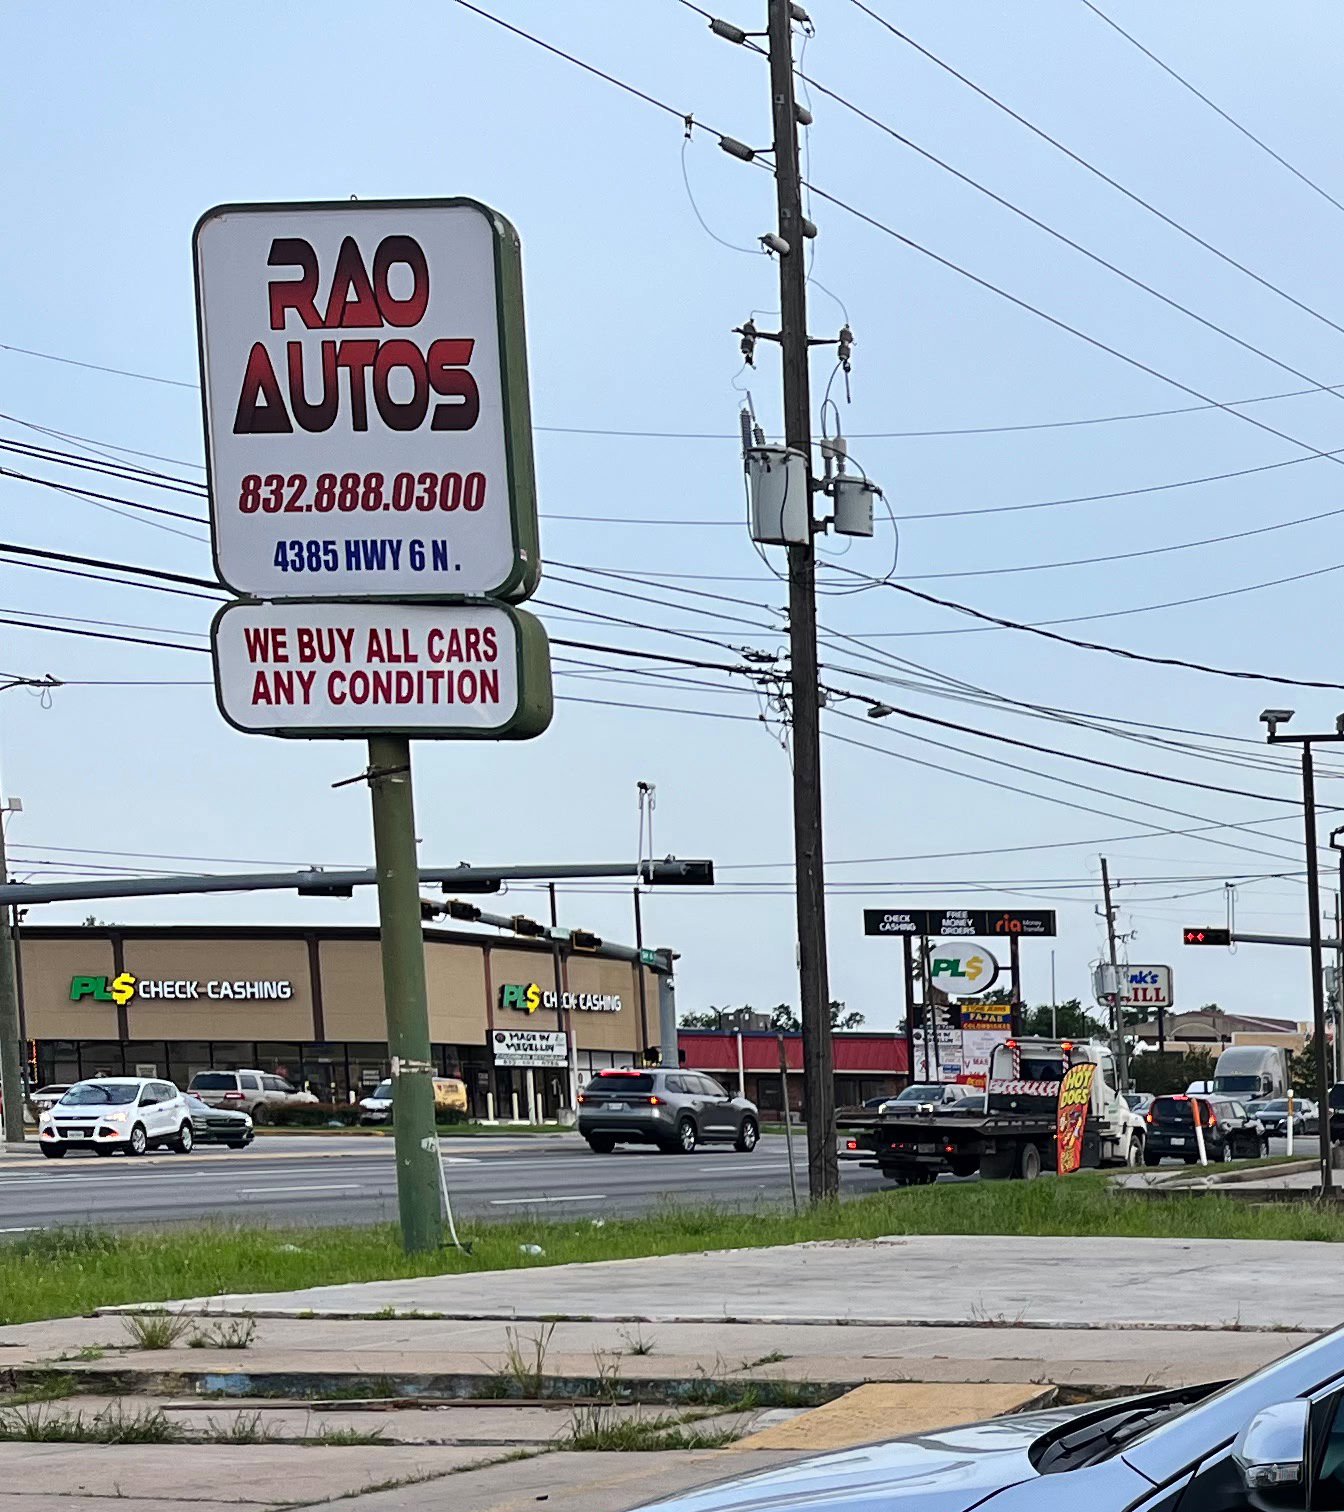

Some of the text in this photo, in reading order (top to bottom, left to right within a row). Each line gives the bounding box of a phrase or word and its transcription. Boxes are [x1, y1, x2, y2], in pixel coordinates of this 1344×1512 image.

[267, 235, 430, 331] RAO
[233, 338, 481, 435] AUTOS
[238, 471, 487, 514] 832.888.0300
[273, 540, 339, 573] 4385
[344, 538, 403, 572] HWY
[409, 539, 426, 572] 6
[243, 626, 498, 664] WE BUY ALL CARS
[251, 668, 500, 706] ANY CONDITION
[884, 914, 911, 923] CHECK
[941, 918, 974, 927] MONEY
[946, 910, 969, 919] FREE
[995, 913, 1022, 933] ria
[1022, 919, 1042, 927] Money
[879, 922, 917, 932] CASHING
[940, 926, 976, 935] ORDERS
[138, 980, 199, 999] CHECK
[206, 980, 293, 999] CASHING
[579, 993, 622, 1012] CASHING
[1066, 1070, 1092, 1091] HOT
[1061, 1088, 1089, 1109] DOGS
